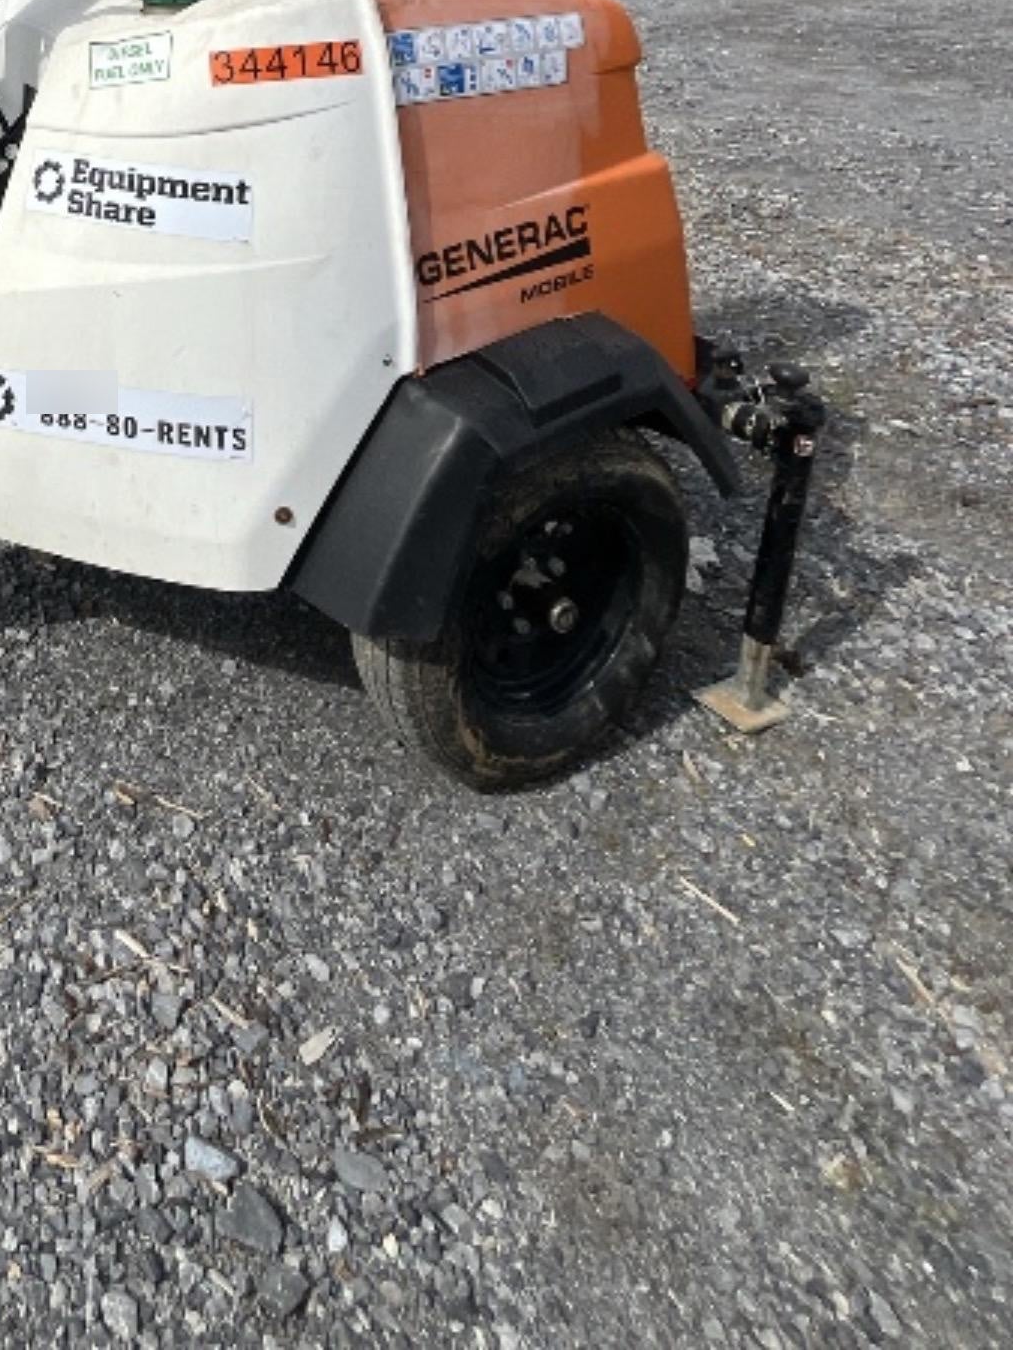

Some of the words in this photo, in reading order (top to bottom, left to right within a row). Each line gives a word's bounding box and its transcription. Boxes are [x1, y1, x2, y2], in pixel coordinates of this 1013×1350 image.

[213, 41, 361, 84] 344146
[71, 158, 252, 205] Equipment
[67, 189, 156, 227] Share
[416, 205, 588, 286] GENERAC
[520, 263, 595, 304] MOBILE
